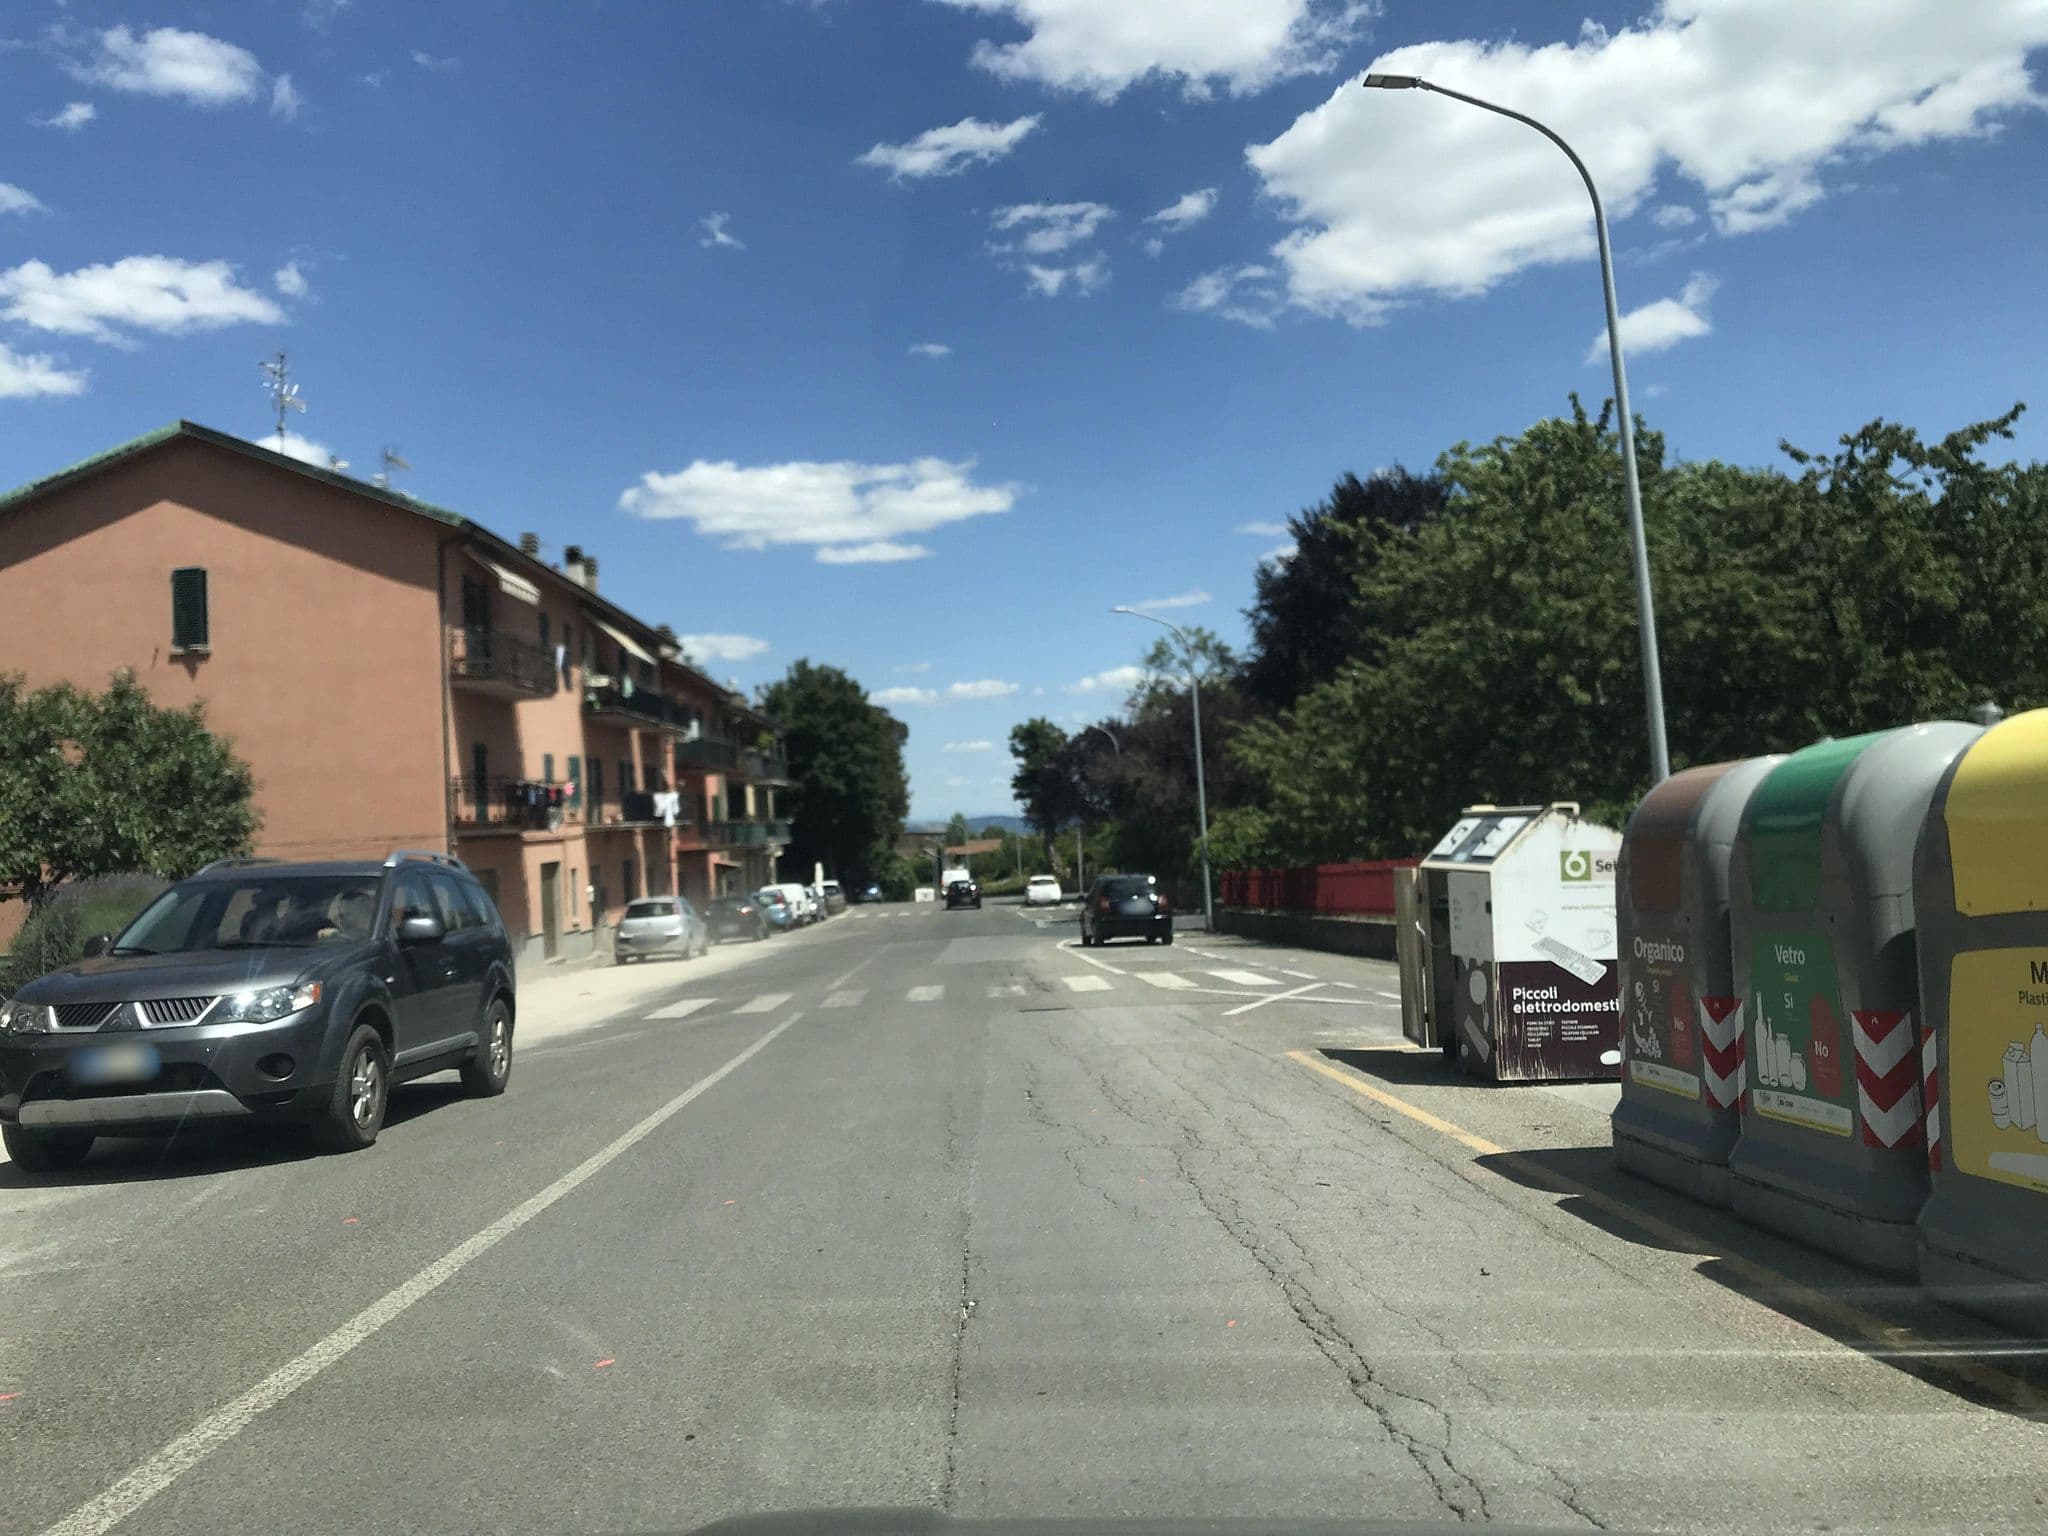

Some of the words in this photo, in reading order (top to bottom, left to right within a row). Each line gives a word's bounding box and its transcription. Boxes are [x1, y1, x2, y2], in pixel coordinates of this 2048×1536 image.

[1634, 936, 1685, 965] Organico
[1774, 944, 1806, 965] Vetro
[1512, 986, 1558, 1000] Piccoli
[1513, 998, 1619, 1014] elettrodomesti
[1814, 1040, 1829, 1058] No
